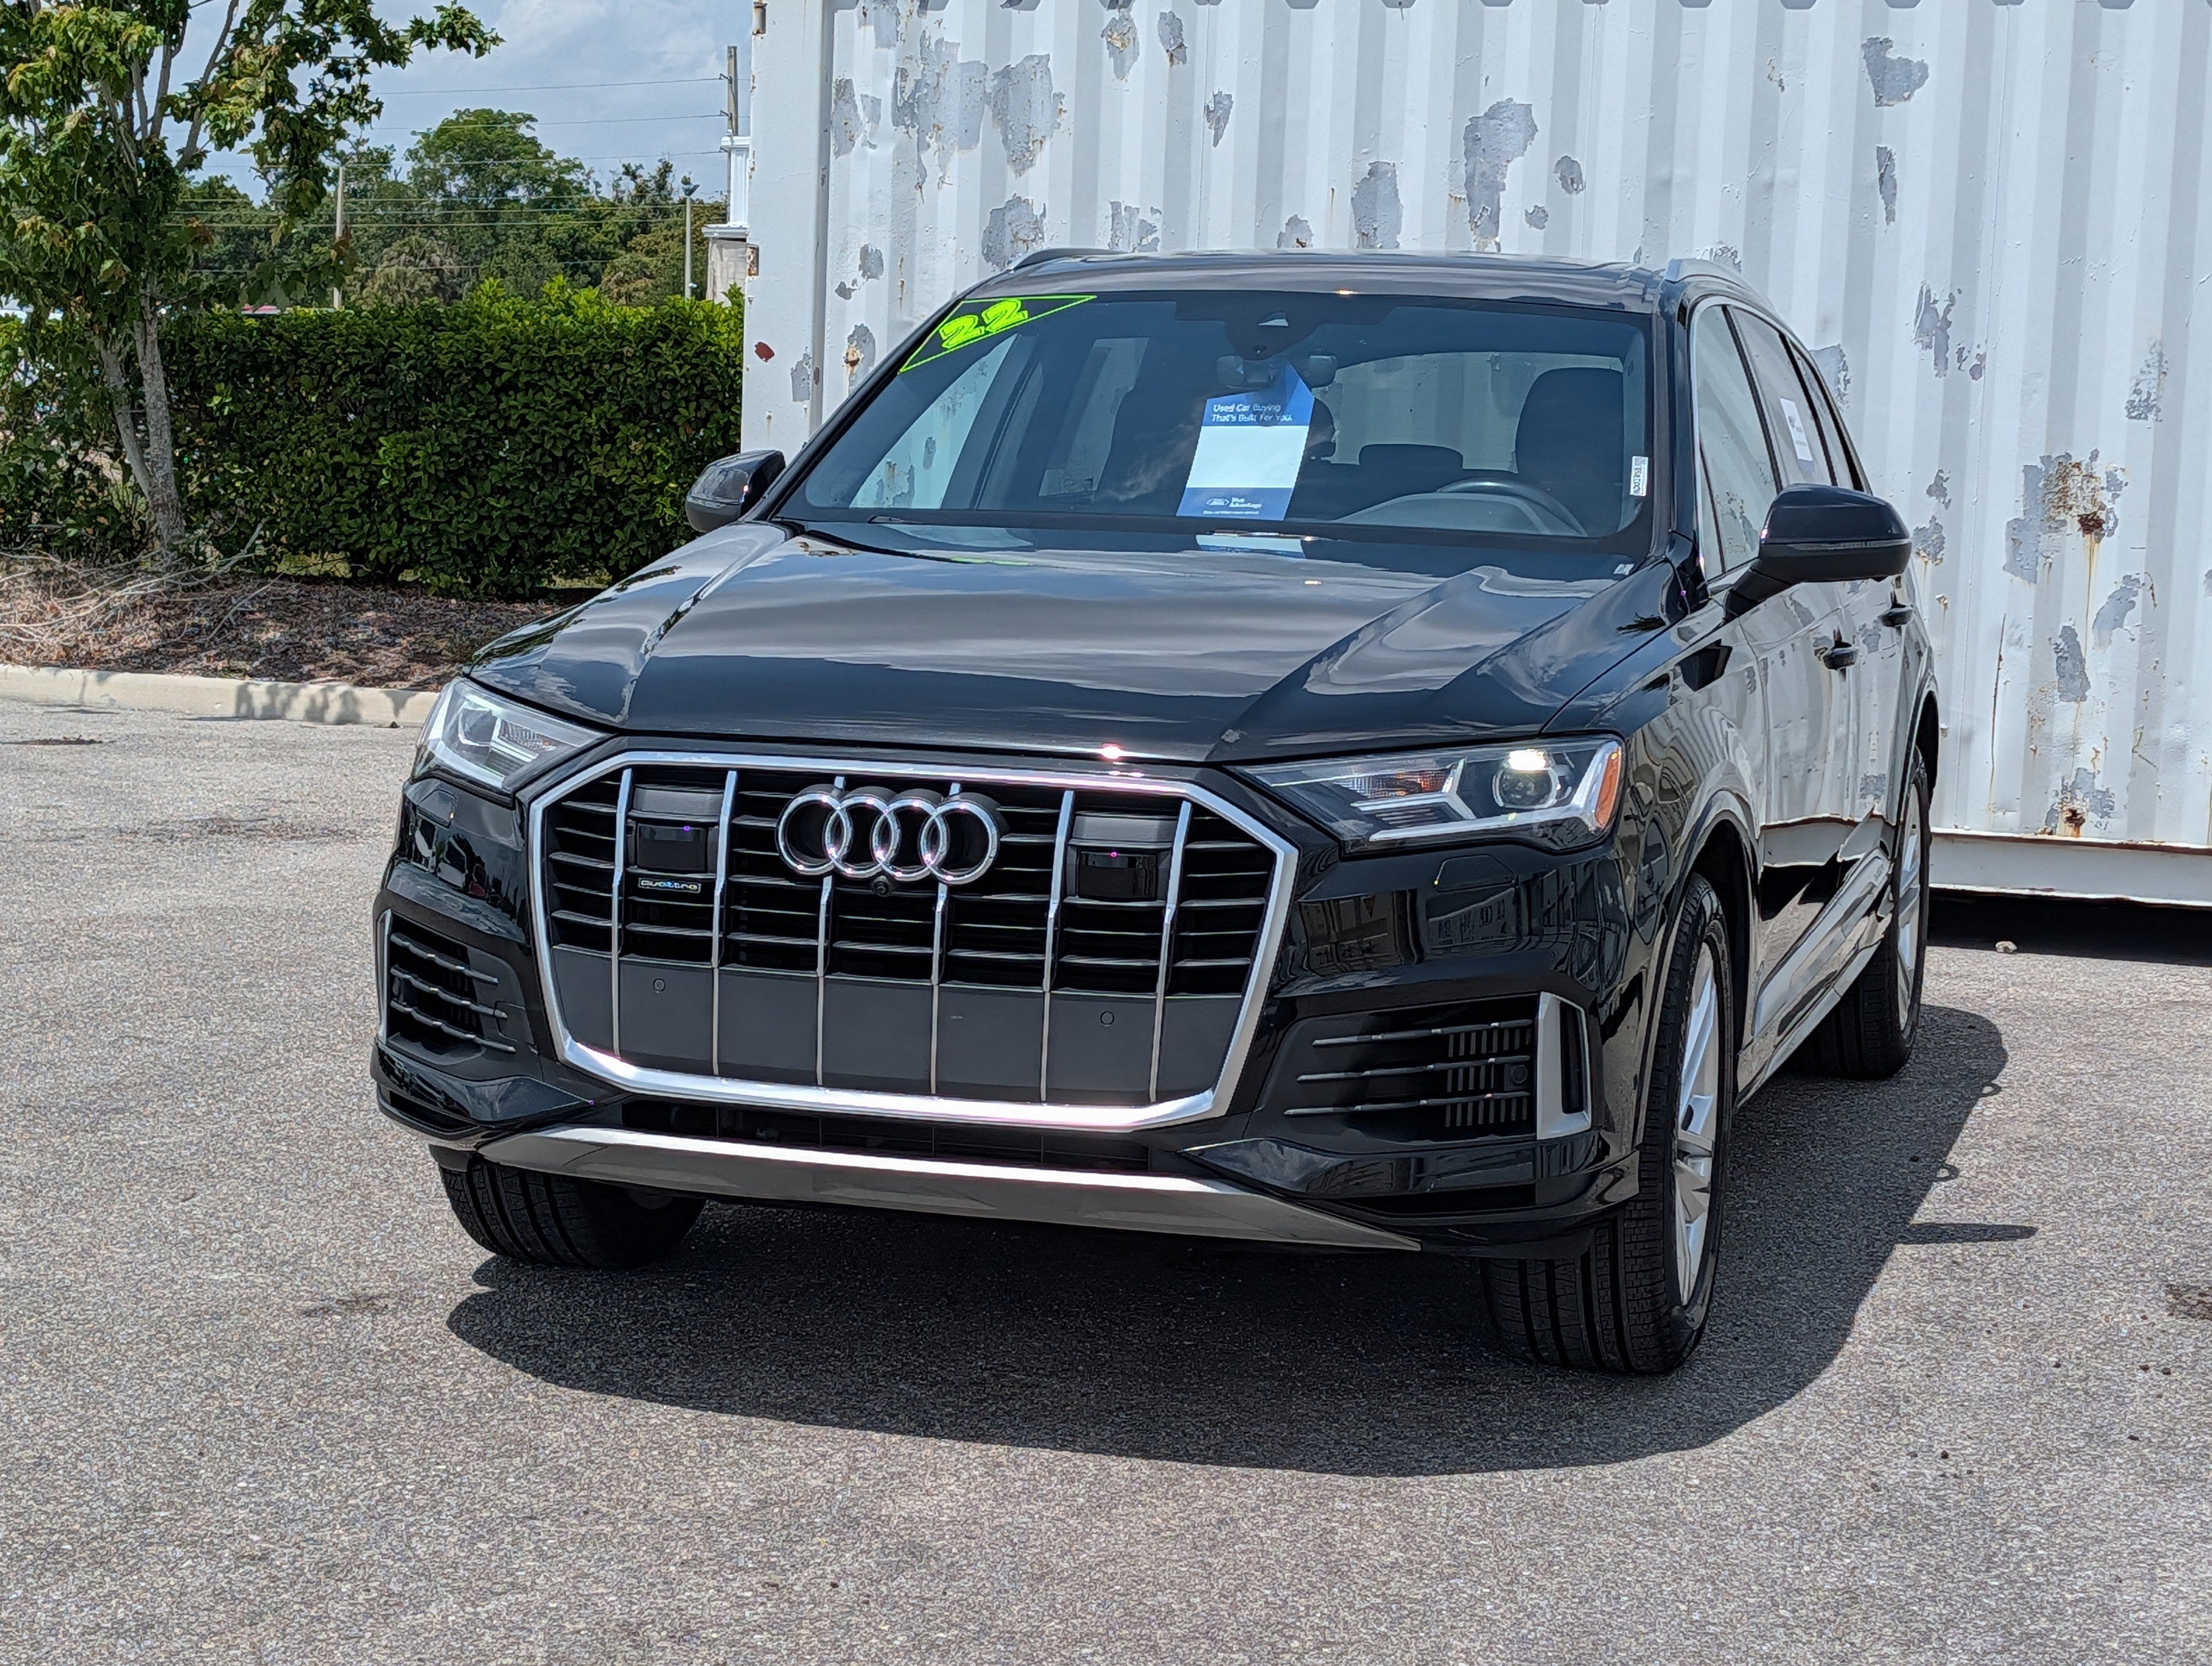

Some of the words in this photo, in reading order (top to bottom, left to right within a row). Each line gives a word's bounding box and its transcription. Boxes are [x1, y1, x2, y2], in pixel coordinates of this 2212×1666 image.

[939, 299, 1028, 349] 22
[1213, 403, 1235, 412] Used
[1236, 403, 1251, 412] Car
[1212, 414, 1237, 422] That's
